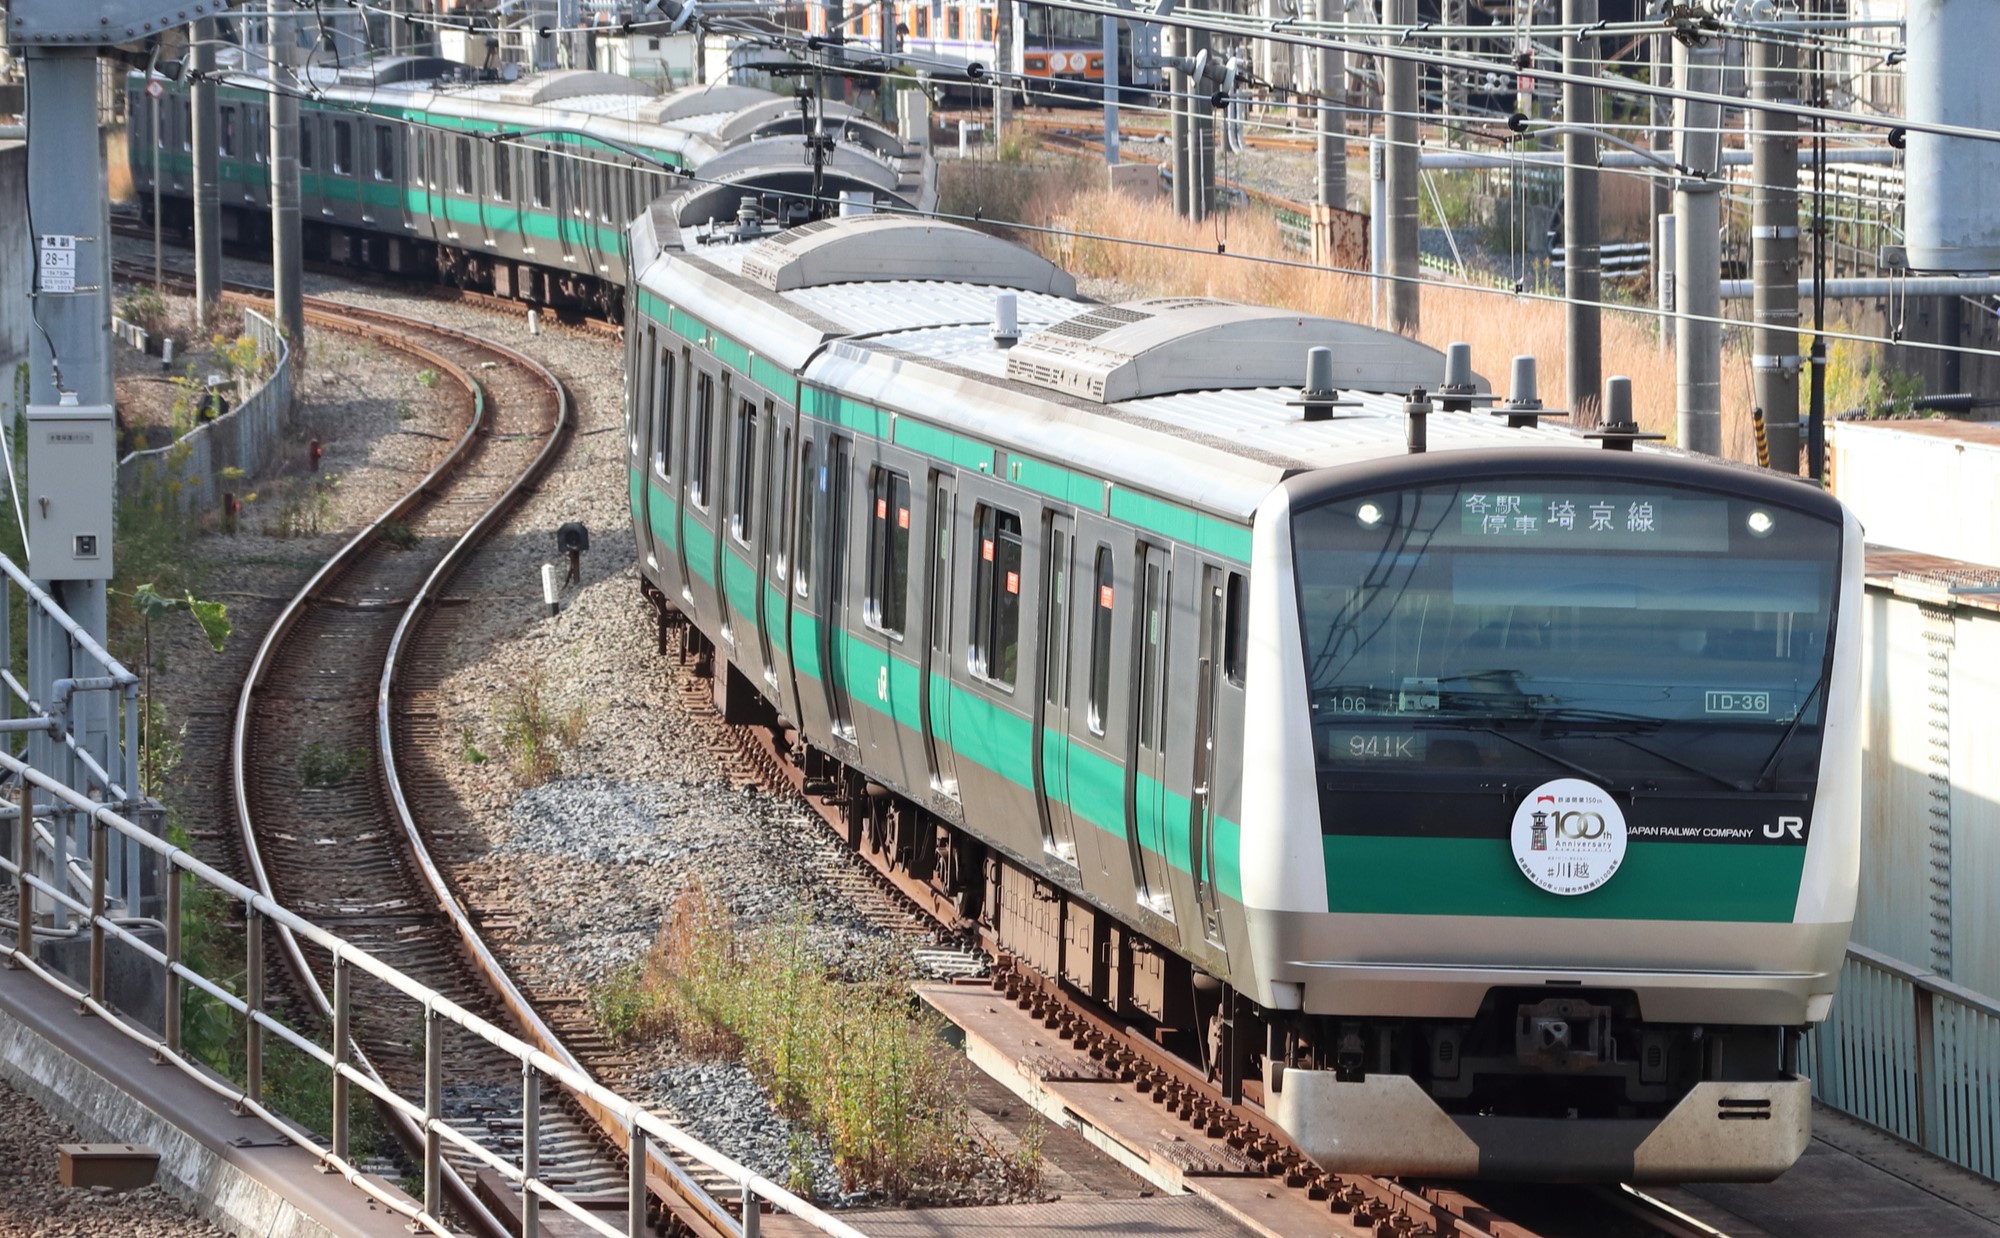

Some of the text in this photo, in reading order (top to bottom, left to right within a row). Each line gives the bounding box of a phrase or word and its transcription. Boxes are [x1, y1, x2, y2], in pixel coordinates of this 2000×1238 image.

[45, 252, 70, 266] 28-1
[1465, 494, 1521, 514] 各駅
[1481, 514, 1538, 535] 停車
[1547, 500, 1655, 532] 埼京線
[877, 665, 888, 703] JR
[1330, 697, 1366, 713] 106
[1350, 735, 1414, 757] 941K
[1627, 826, 1754, 838] JAPAN RAILWAY COMPANY
[1763, 816, 1803, 839] JR
[1555, 840, 1612, 849] Anniversary
[1547, 862, 1590, 878] #川越
